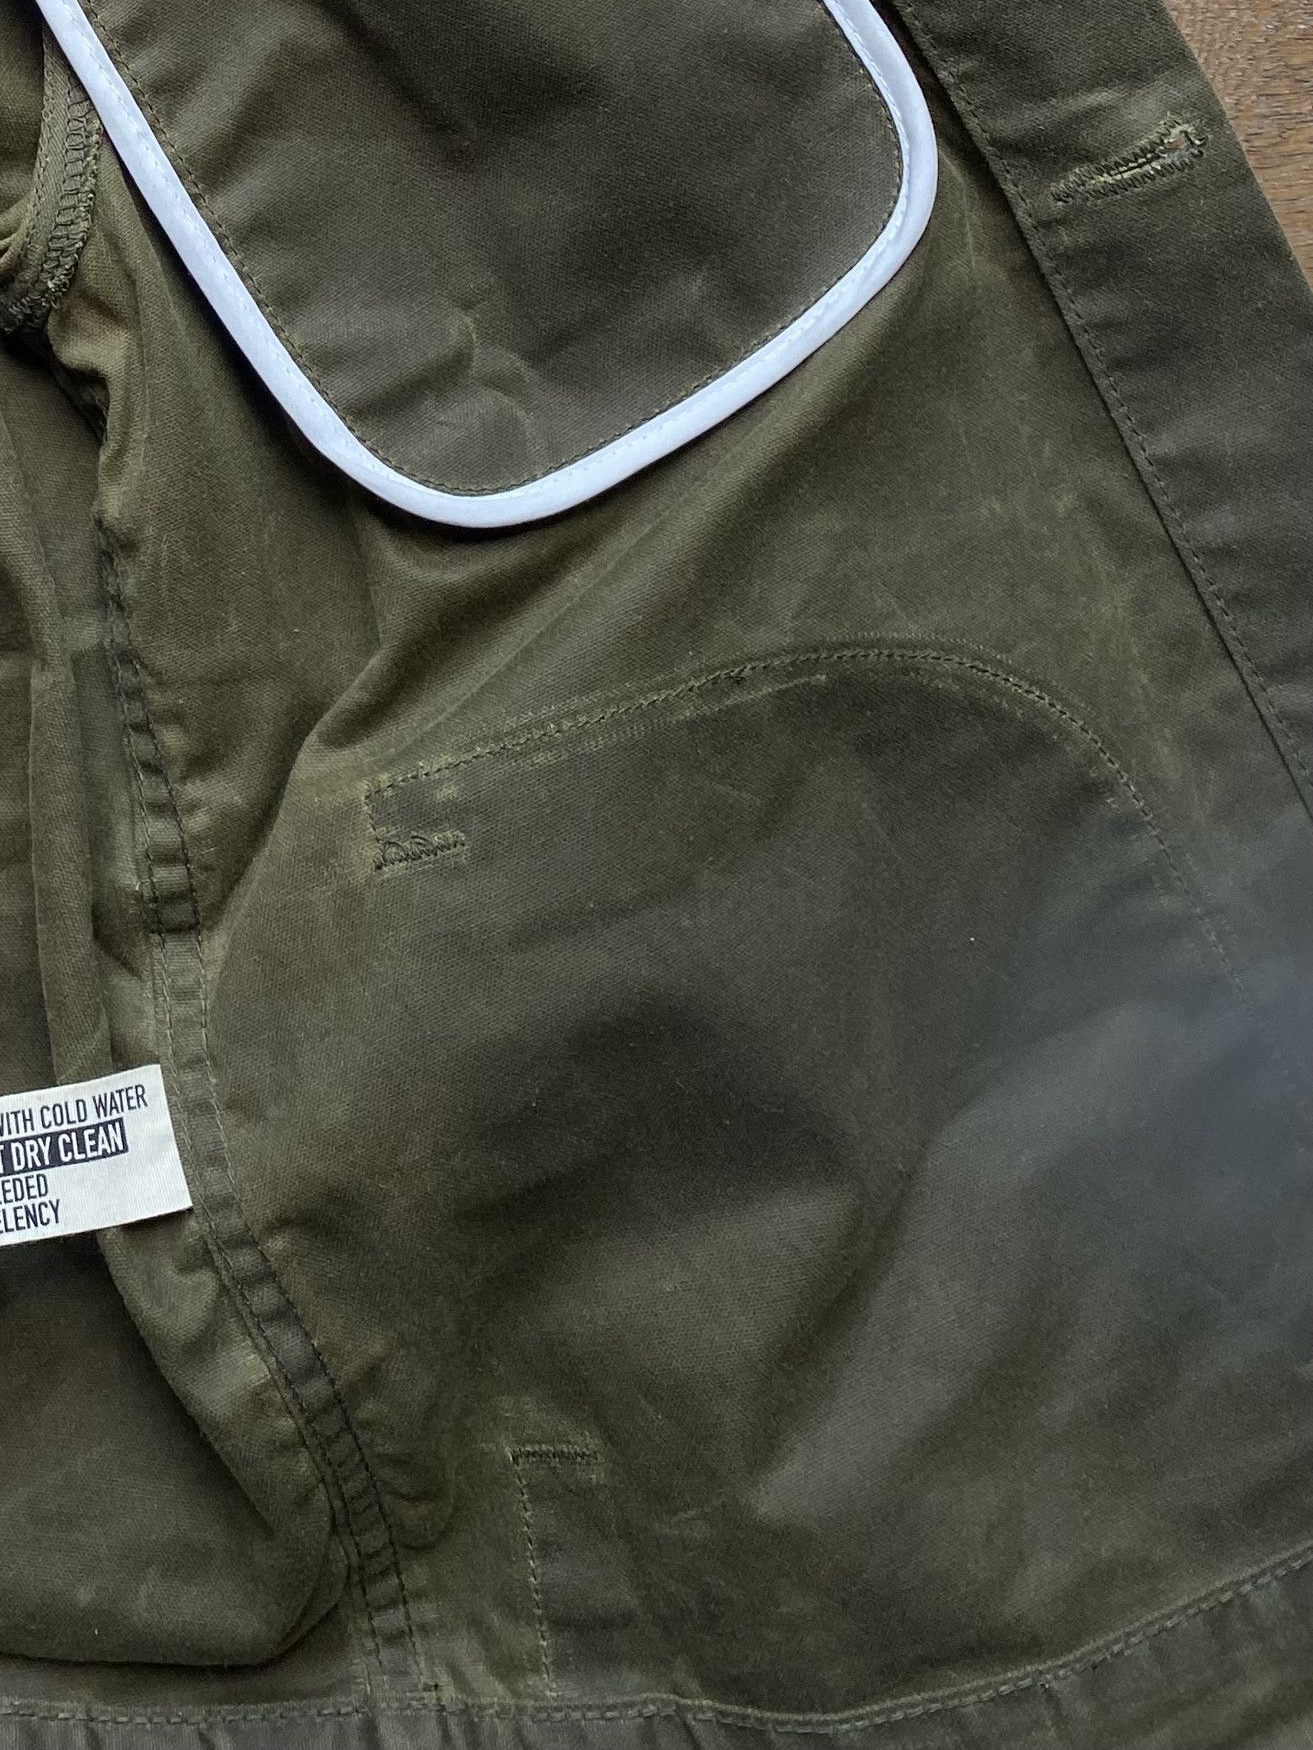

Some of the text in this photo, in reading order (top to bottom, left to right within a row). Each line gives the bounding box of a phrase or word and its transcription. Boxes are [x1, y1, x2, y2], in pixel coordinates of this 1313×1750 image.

[40, 1099, 88, 1129] COLD
[92, 1084, 149, 1120] WATER
[10, 1136, 53, 1172] DRY
[57, 1120, 125, 1163] CLEAN
